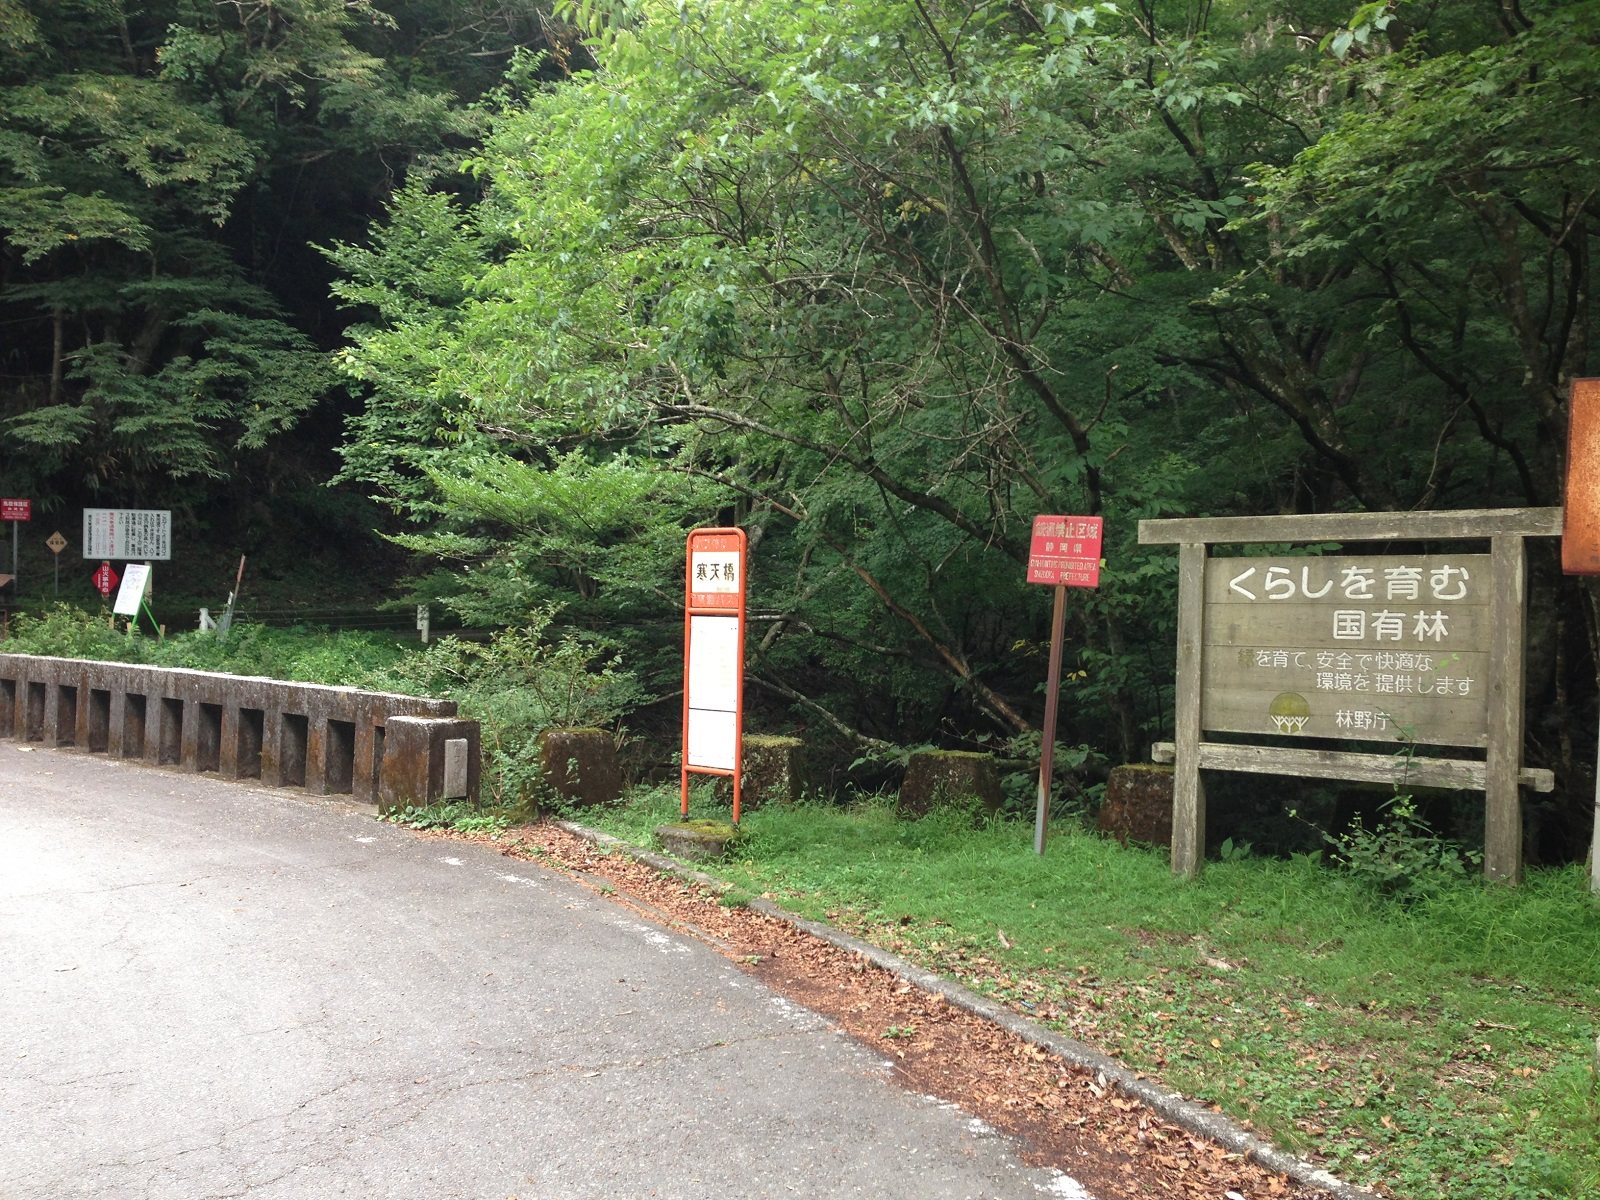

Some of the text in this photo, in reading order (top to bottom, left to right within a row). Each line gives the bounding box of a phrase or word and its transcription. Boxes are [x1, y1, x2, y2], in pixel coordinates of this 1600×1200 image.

[696, 562, 735, 582] 寒天橋
[1229, 564, 1470, 601] くらしを育む
[1332, 609, 1449, 642] 国有林
[1335, 709, 1391, 731] 林野庁
